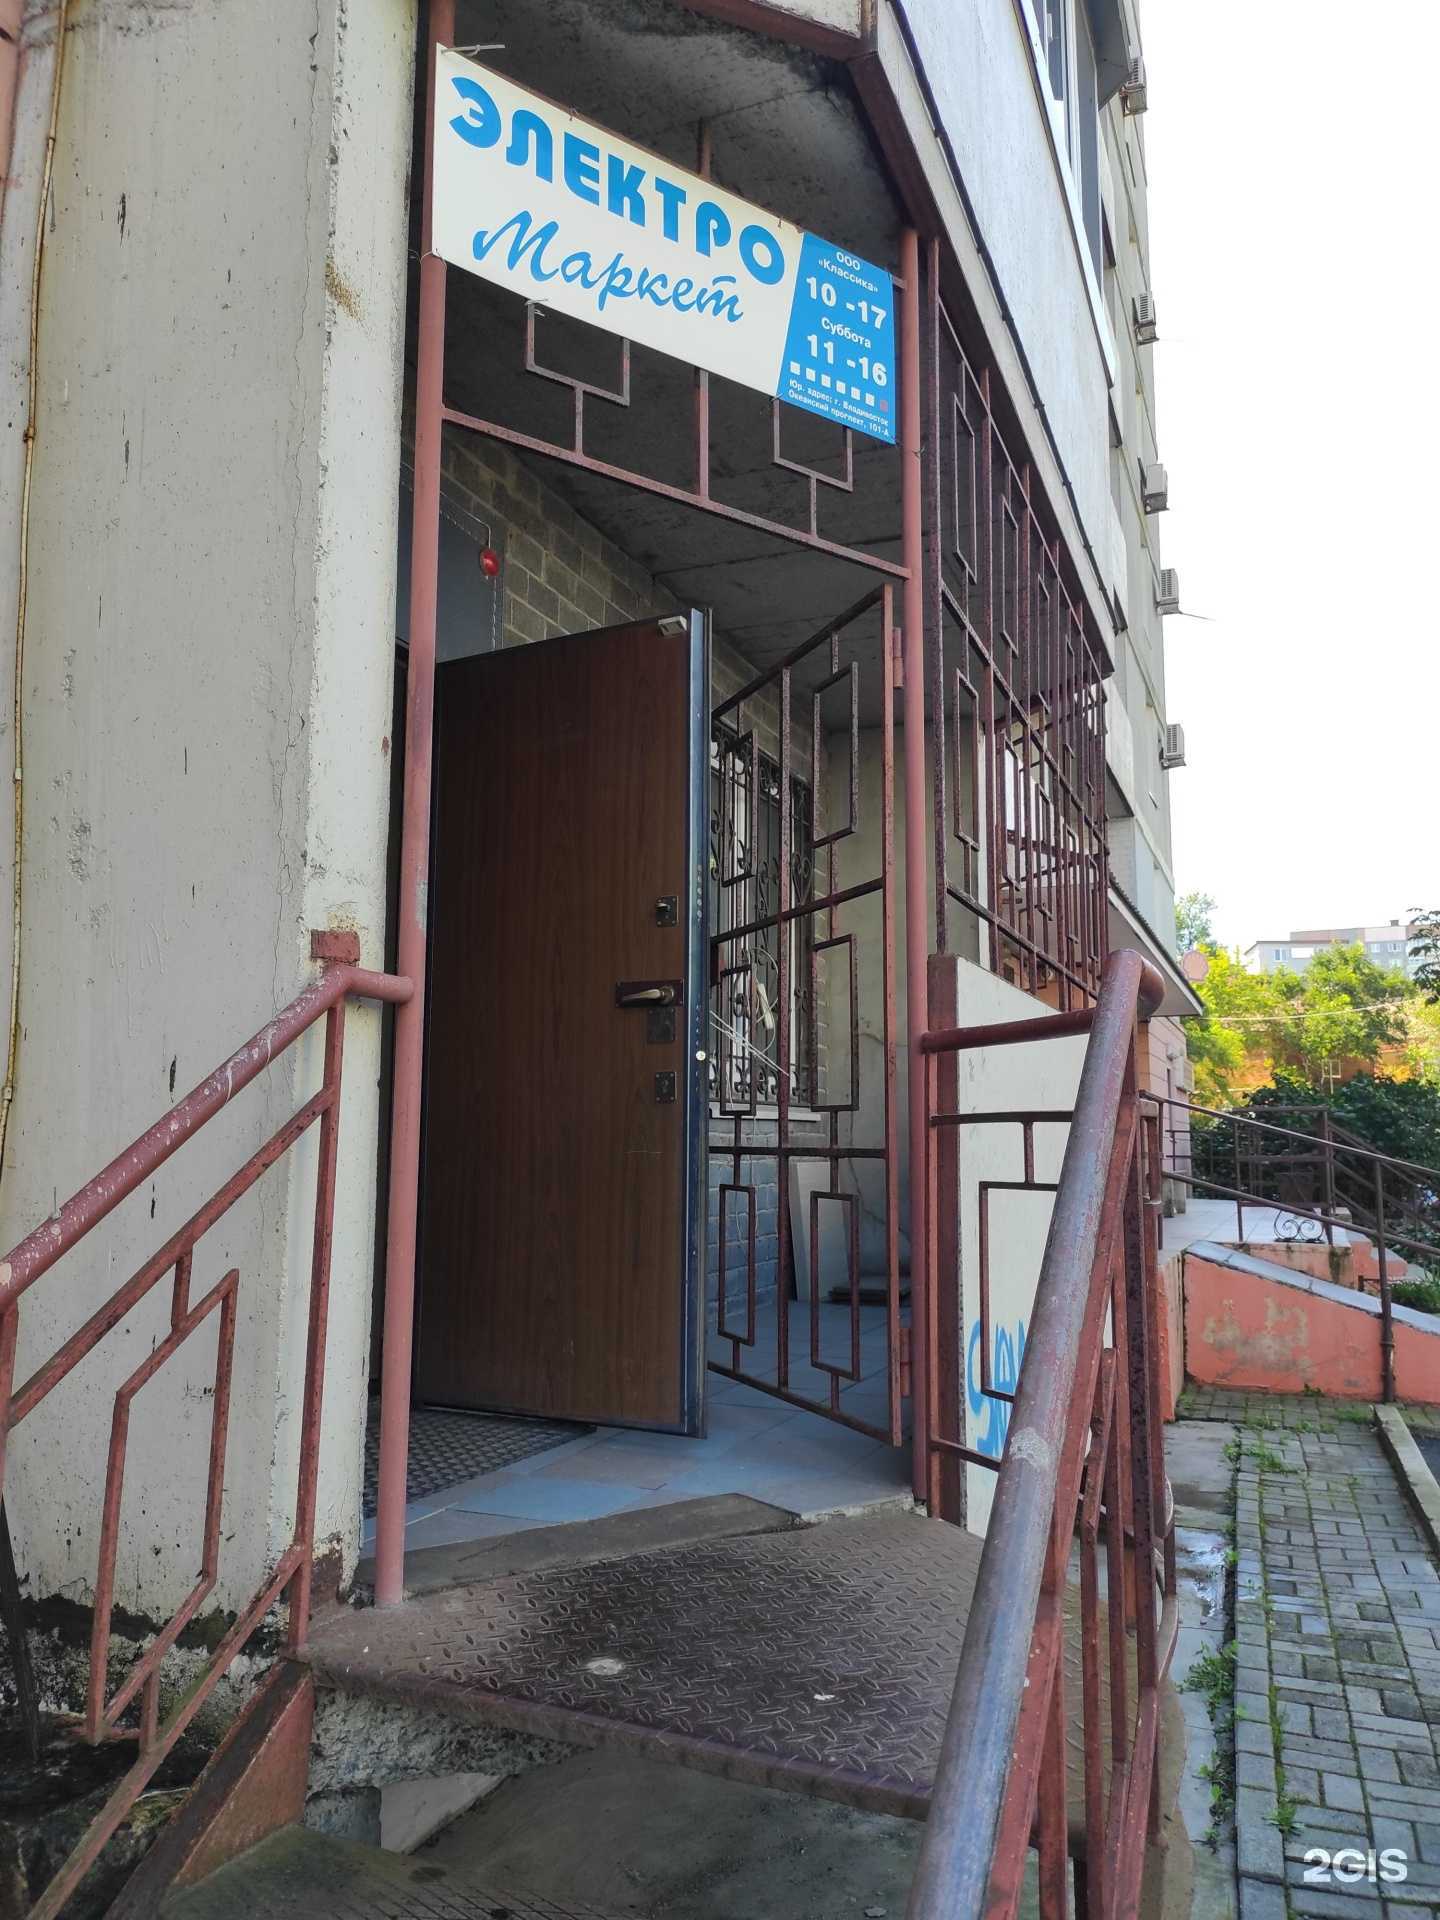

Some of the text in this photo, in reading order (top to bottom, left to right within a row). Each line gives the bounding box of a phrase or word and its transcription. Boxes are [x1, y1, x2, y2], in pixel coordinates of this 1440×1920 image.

[449, 77, 785, 286] ЭЛЕКТРО
[472, 210, 744, 323] Маркет
[818, 258, 879, 293] «Классика»
[836, 251, 861, 271] ООО
[806, 276, 887, 330] 10 -17
[821, 316, 872, 349] Суббота
[807, 334, 888, 387] 11 -16
